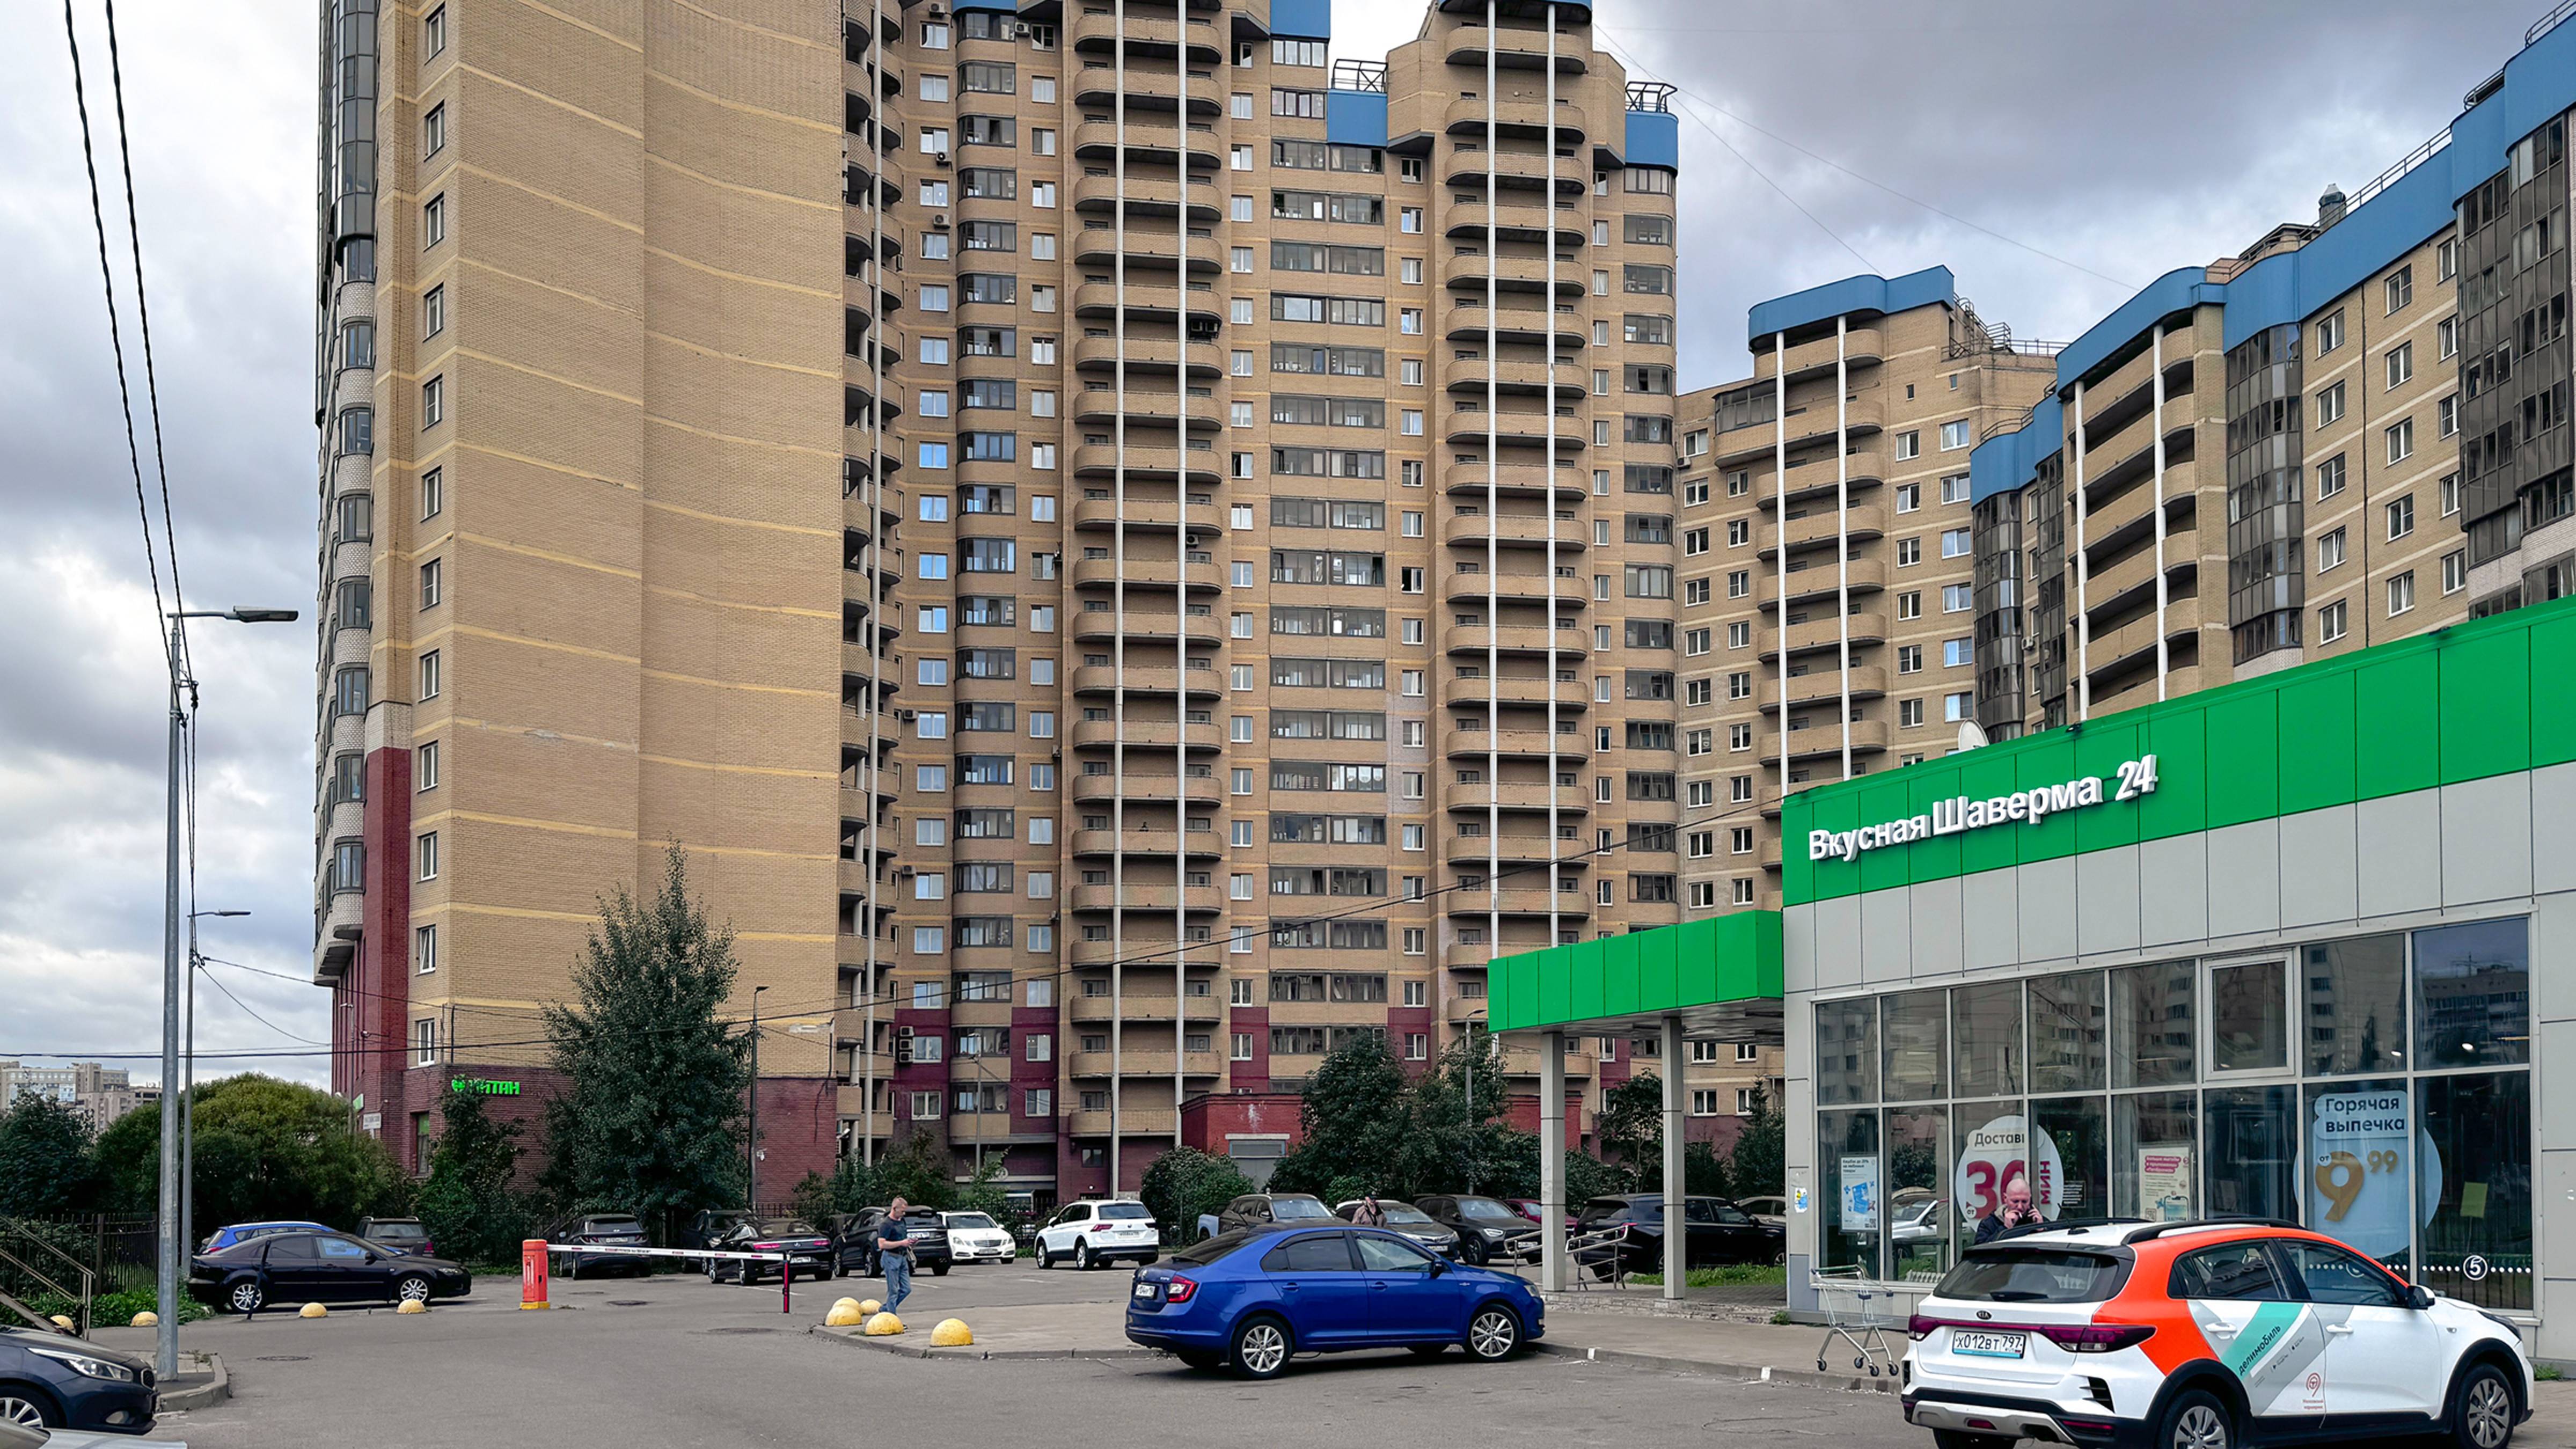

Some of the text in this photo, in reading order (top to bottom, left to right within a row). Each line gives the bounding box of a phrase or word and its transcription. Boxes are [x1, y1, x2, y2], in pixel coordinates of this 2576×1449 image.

[1809, 753, 2159, 862] Вкусная Шаверма 24
[2325, 1097, 2400, 1115] Горячая
[2325, 1118, 2405, 1132] выпечка
[2315, 1151, 2365, 1223] 9
[2367, 1149, 2399, 1174] 99
[2002, 1336, 2022, 1349] 797
[2238, 1325, 2282, 1376] делимобиль
